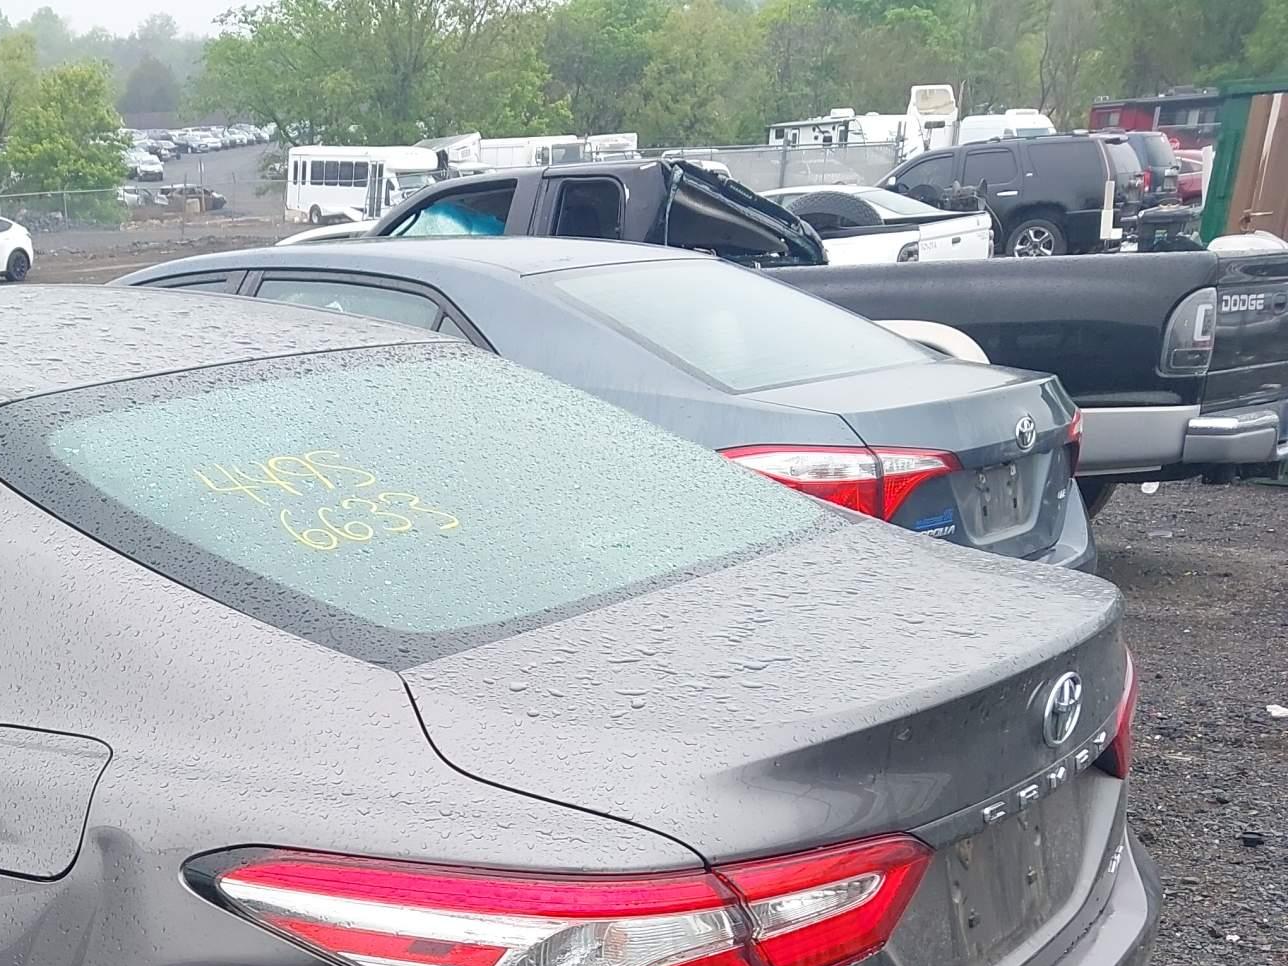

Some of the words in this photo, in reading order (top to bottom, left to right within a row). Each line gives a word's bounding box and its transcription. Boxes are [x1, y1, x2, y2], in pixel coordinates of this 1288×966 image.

[1222, 293, 1265, 312] DODGE
[193, 450, 376, 507] 4495
[280, 492, 460, 550] 6633
[983, 731, 1107, 825] CAMRY
